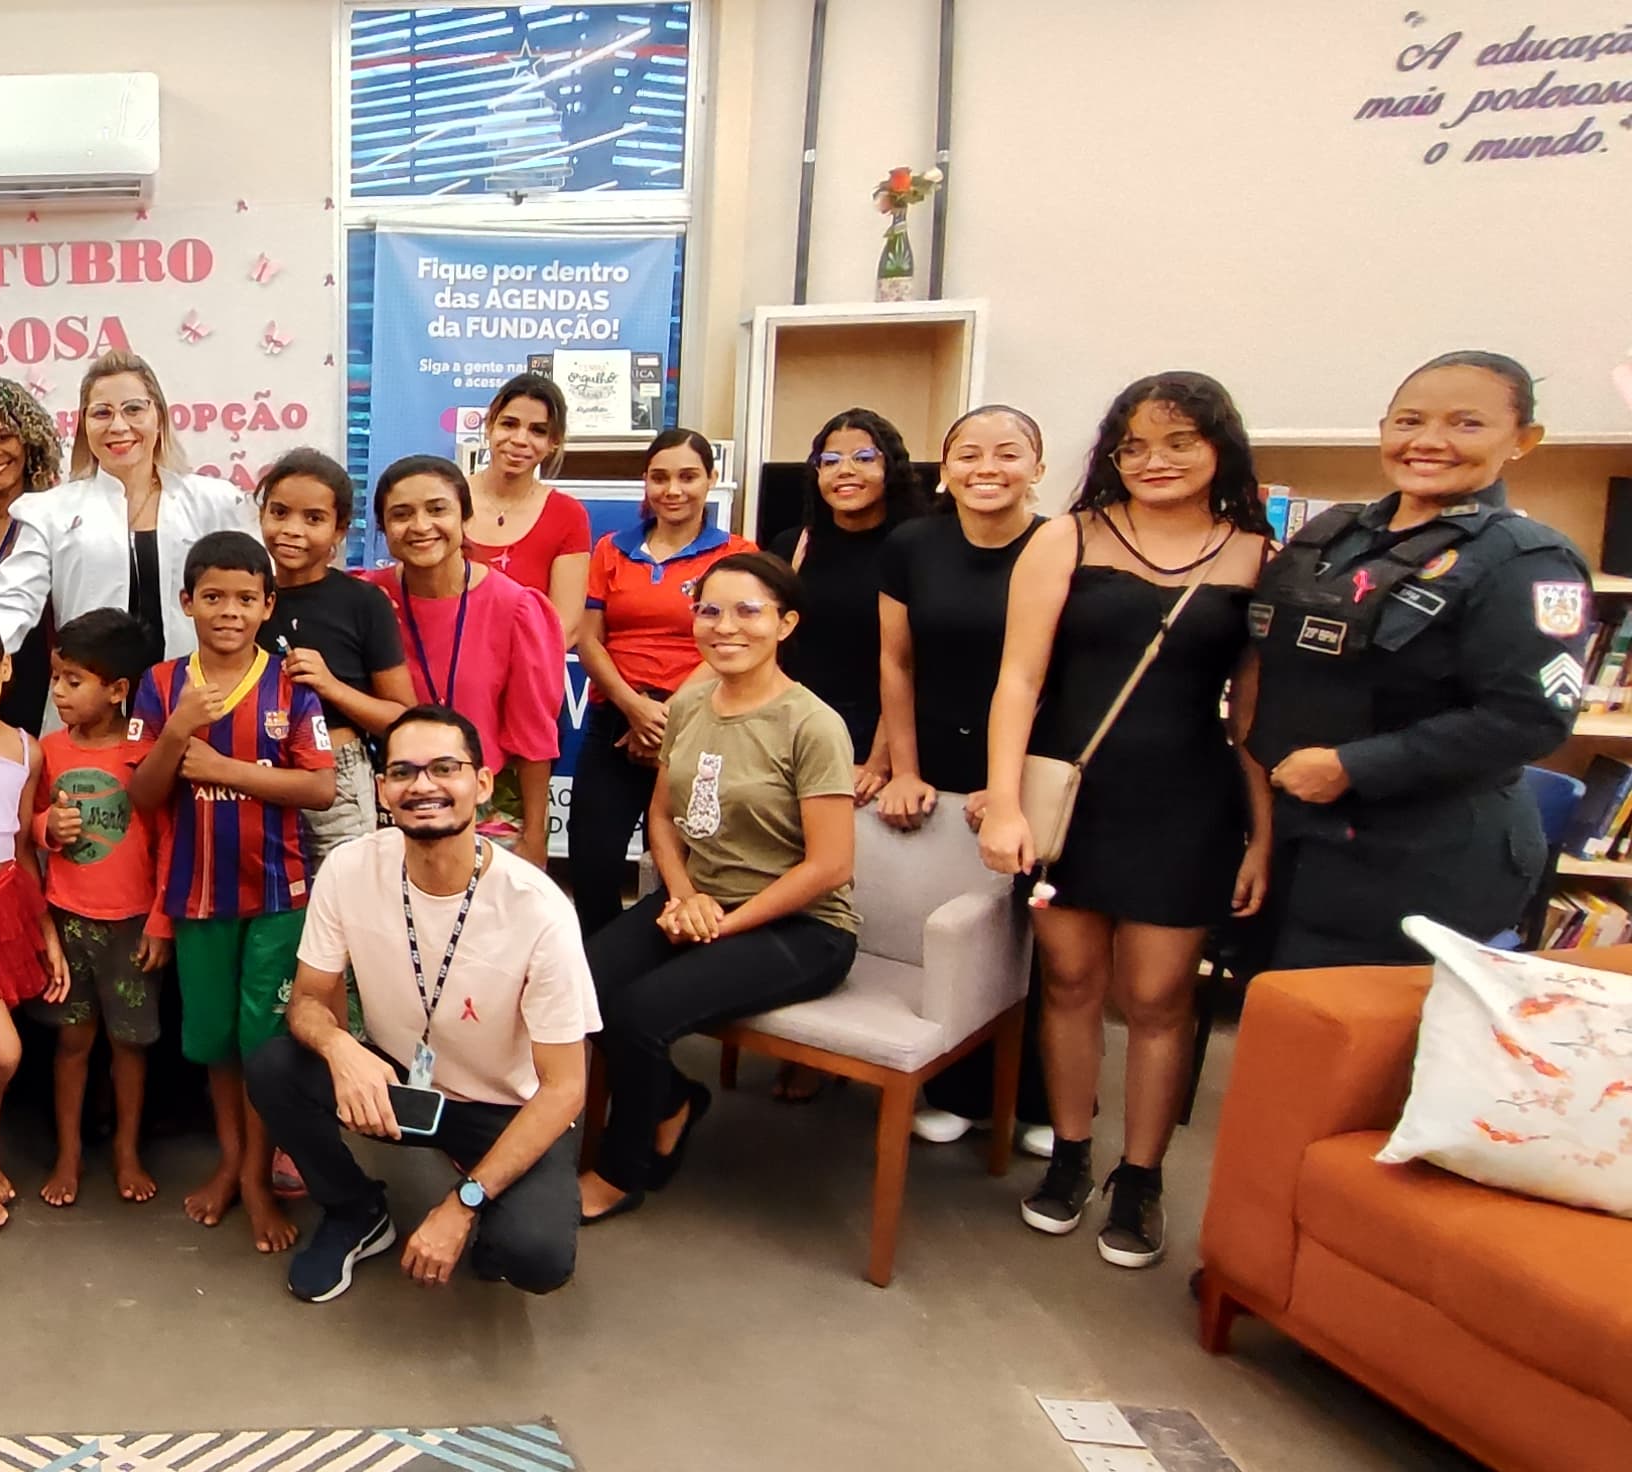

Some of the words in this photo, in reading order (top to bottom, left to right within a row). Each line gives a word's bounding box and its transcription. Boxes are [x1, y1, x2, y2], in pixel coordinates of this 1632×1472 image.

[1353, 86, 1446, 120] mais
[1424, 141, 1449, 164] o
[418, 257, 488, 285] Fique
[493, 264, 537, 286] por
[541, 260, 630, 282] dentro
[434, 286, 480, 309] das
[485, 288, 610, 311] AGENDAS
[428, 315, 461, 337] da
[467, 313, 620, 345] FUNDAÇÃO!
[419, 358, 450, 375] Siga
[452, 362, 461, 372] a
[464, 361, 504, 375] gente
[465, 378, 508, 388] acess
[169, 390, 309, 442] OPÇÃO
